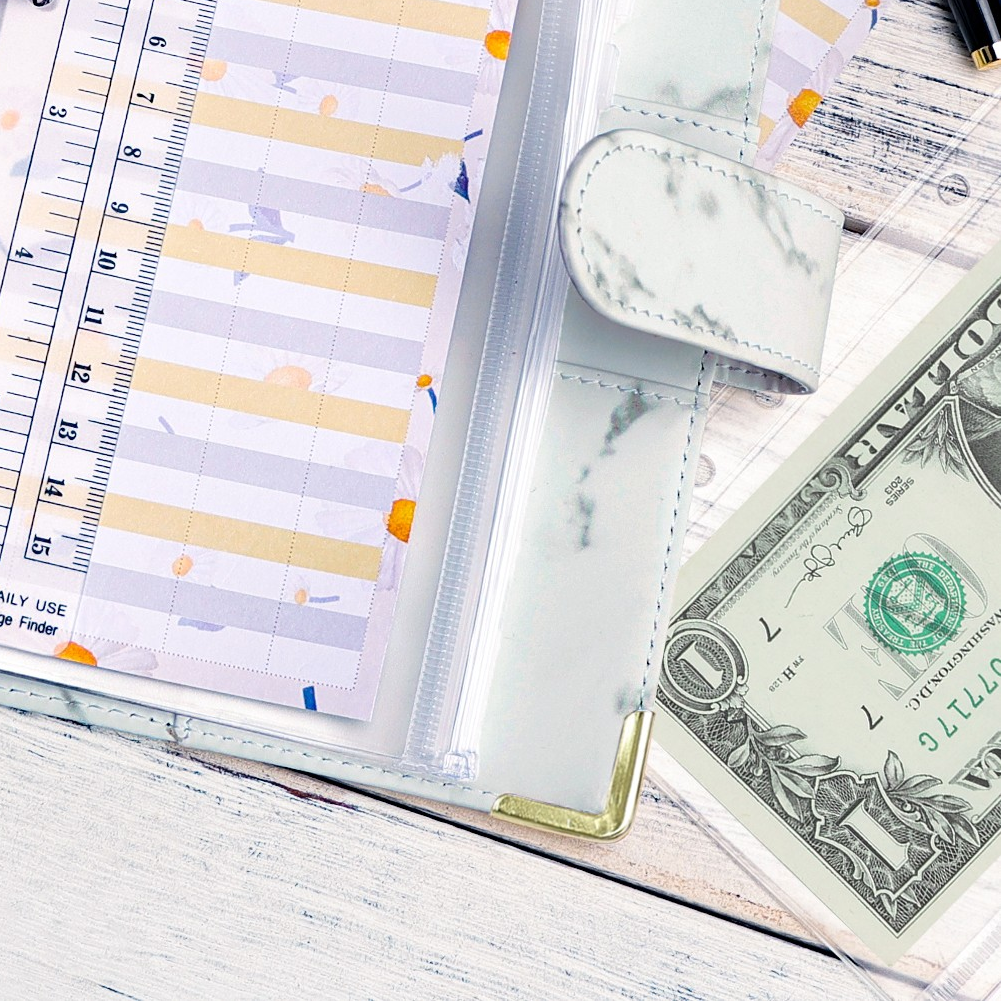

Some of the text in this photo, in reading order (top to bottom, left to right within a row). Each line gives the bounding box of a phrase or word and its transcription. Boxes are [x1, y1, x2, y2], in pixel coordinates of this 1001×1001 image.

[148, 35, 167, 49] 6
[136, 92, 155, 104] 7
[49, 105, 68, 119] 3
[123, 145, 142, 158] 8
[110, 201, 129, 214] 9
[14, 247, 34, 259] 4
[97, 248, 117, 271] 10
[83, 305, 105, 326] 11
[70, 361, 92, 384] 12
[57, 418, 79, 441] 13
[44, 476, 66, 499] 14
[884, 475, 903, 495] 2013
[885, 477, 915, 507] SERIES
[31, 533, 52, 556] 15
[35, 599, 68, 617] USE
[19, 616, 59, 637] Finder
[759, 617, 782, 643] 7
[675, 640, 724, 690] 1
[781, 666, 797, 682] H
[861, 704, 884, 731] 7
[835, 798, 910, 872] 1
